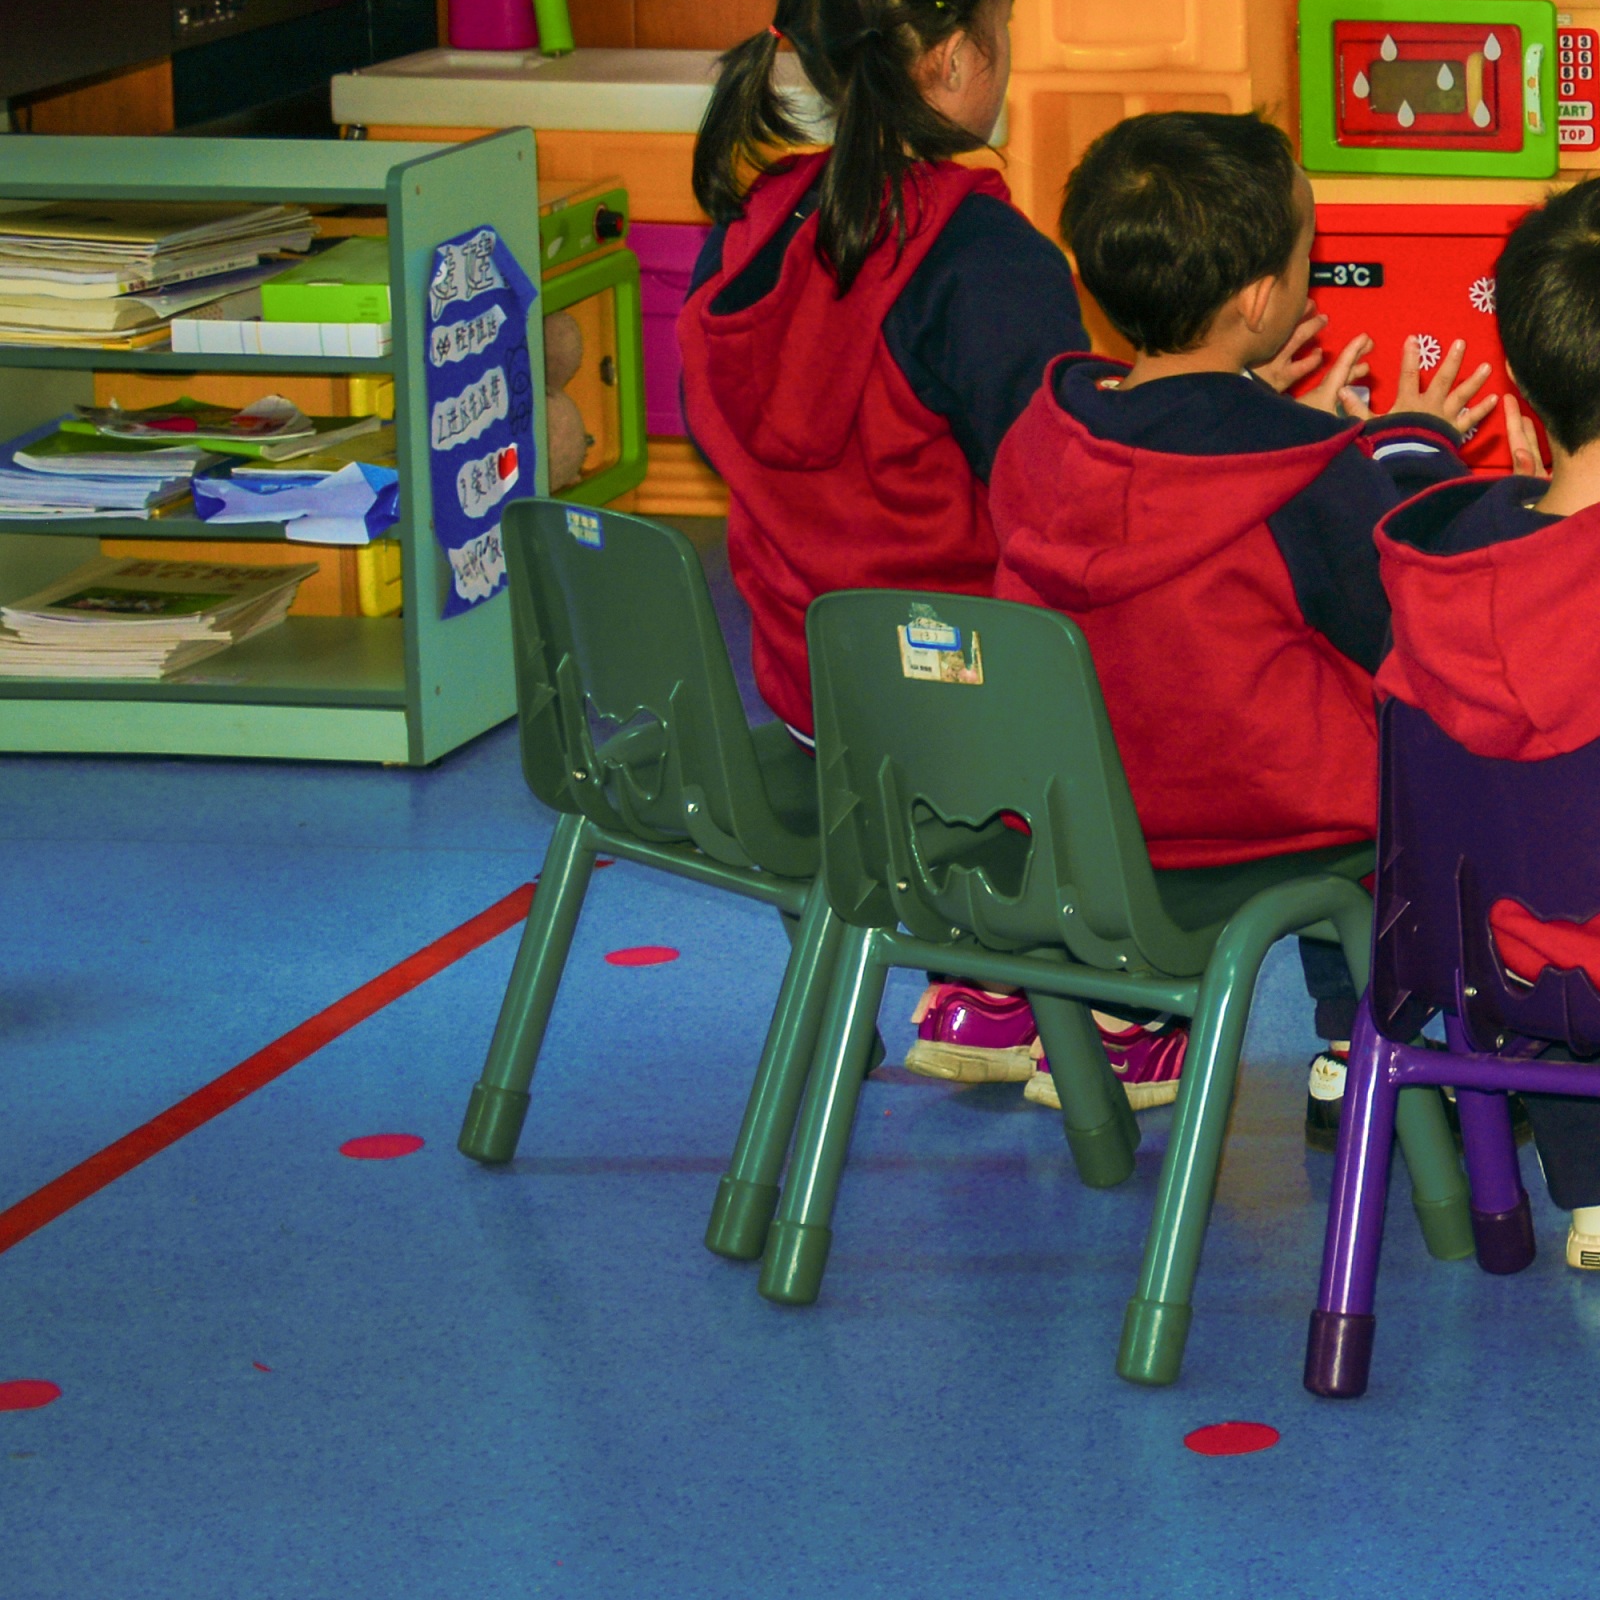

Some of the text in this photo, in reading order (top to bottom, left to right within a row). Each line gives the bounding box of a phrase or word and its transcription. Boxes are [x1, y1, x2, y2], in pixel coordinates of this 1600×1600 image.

[1562, 36, 1570, 47] 2
[1580, 36, 1588, 47] 3
[1581, 52, 1589, 63] 6
[1563, 66, 1571, 78] 8
[1581, 66, 1589, 78] 9
[1563, 83, 1571, 94] 0
